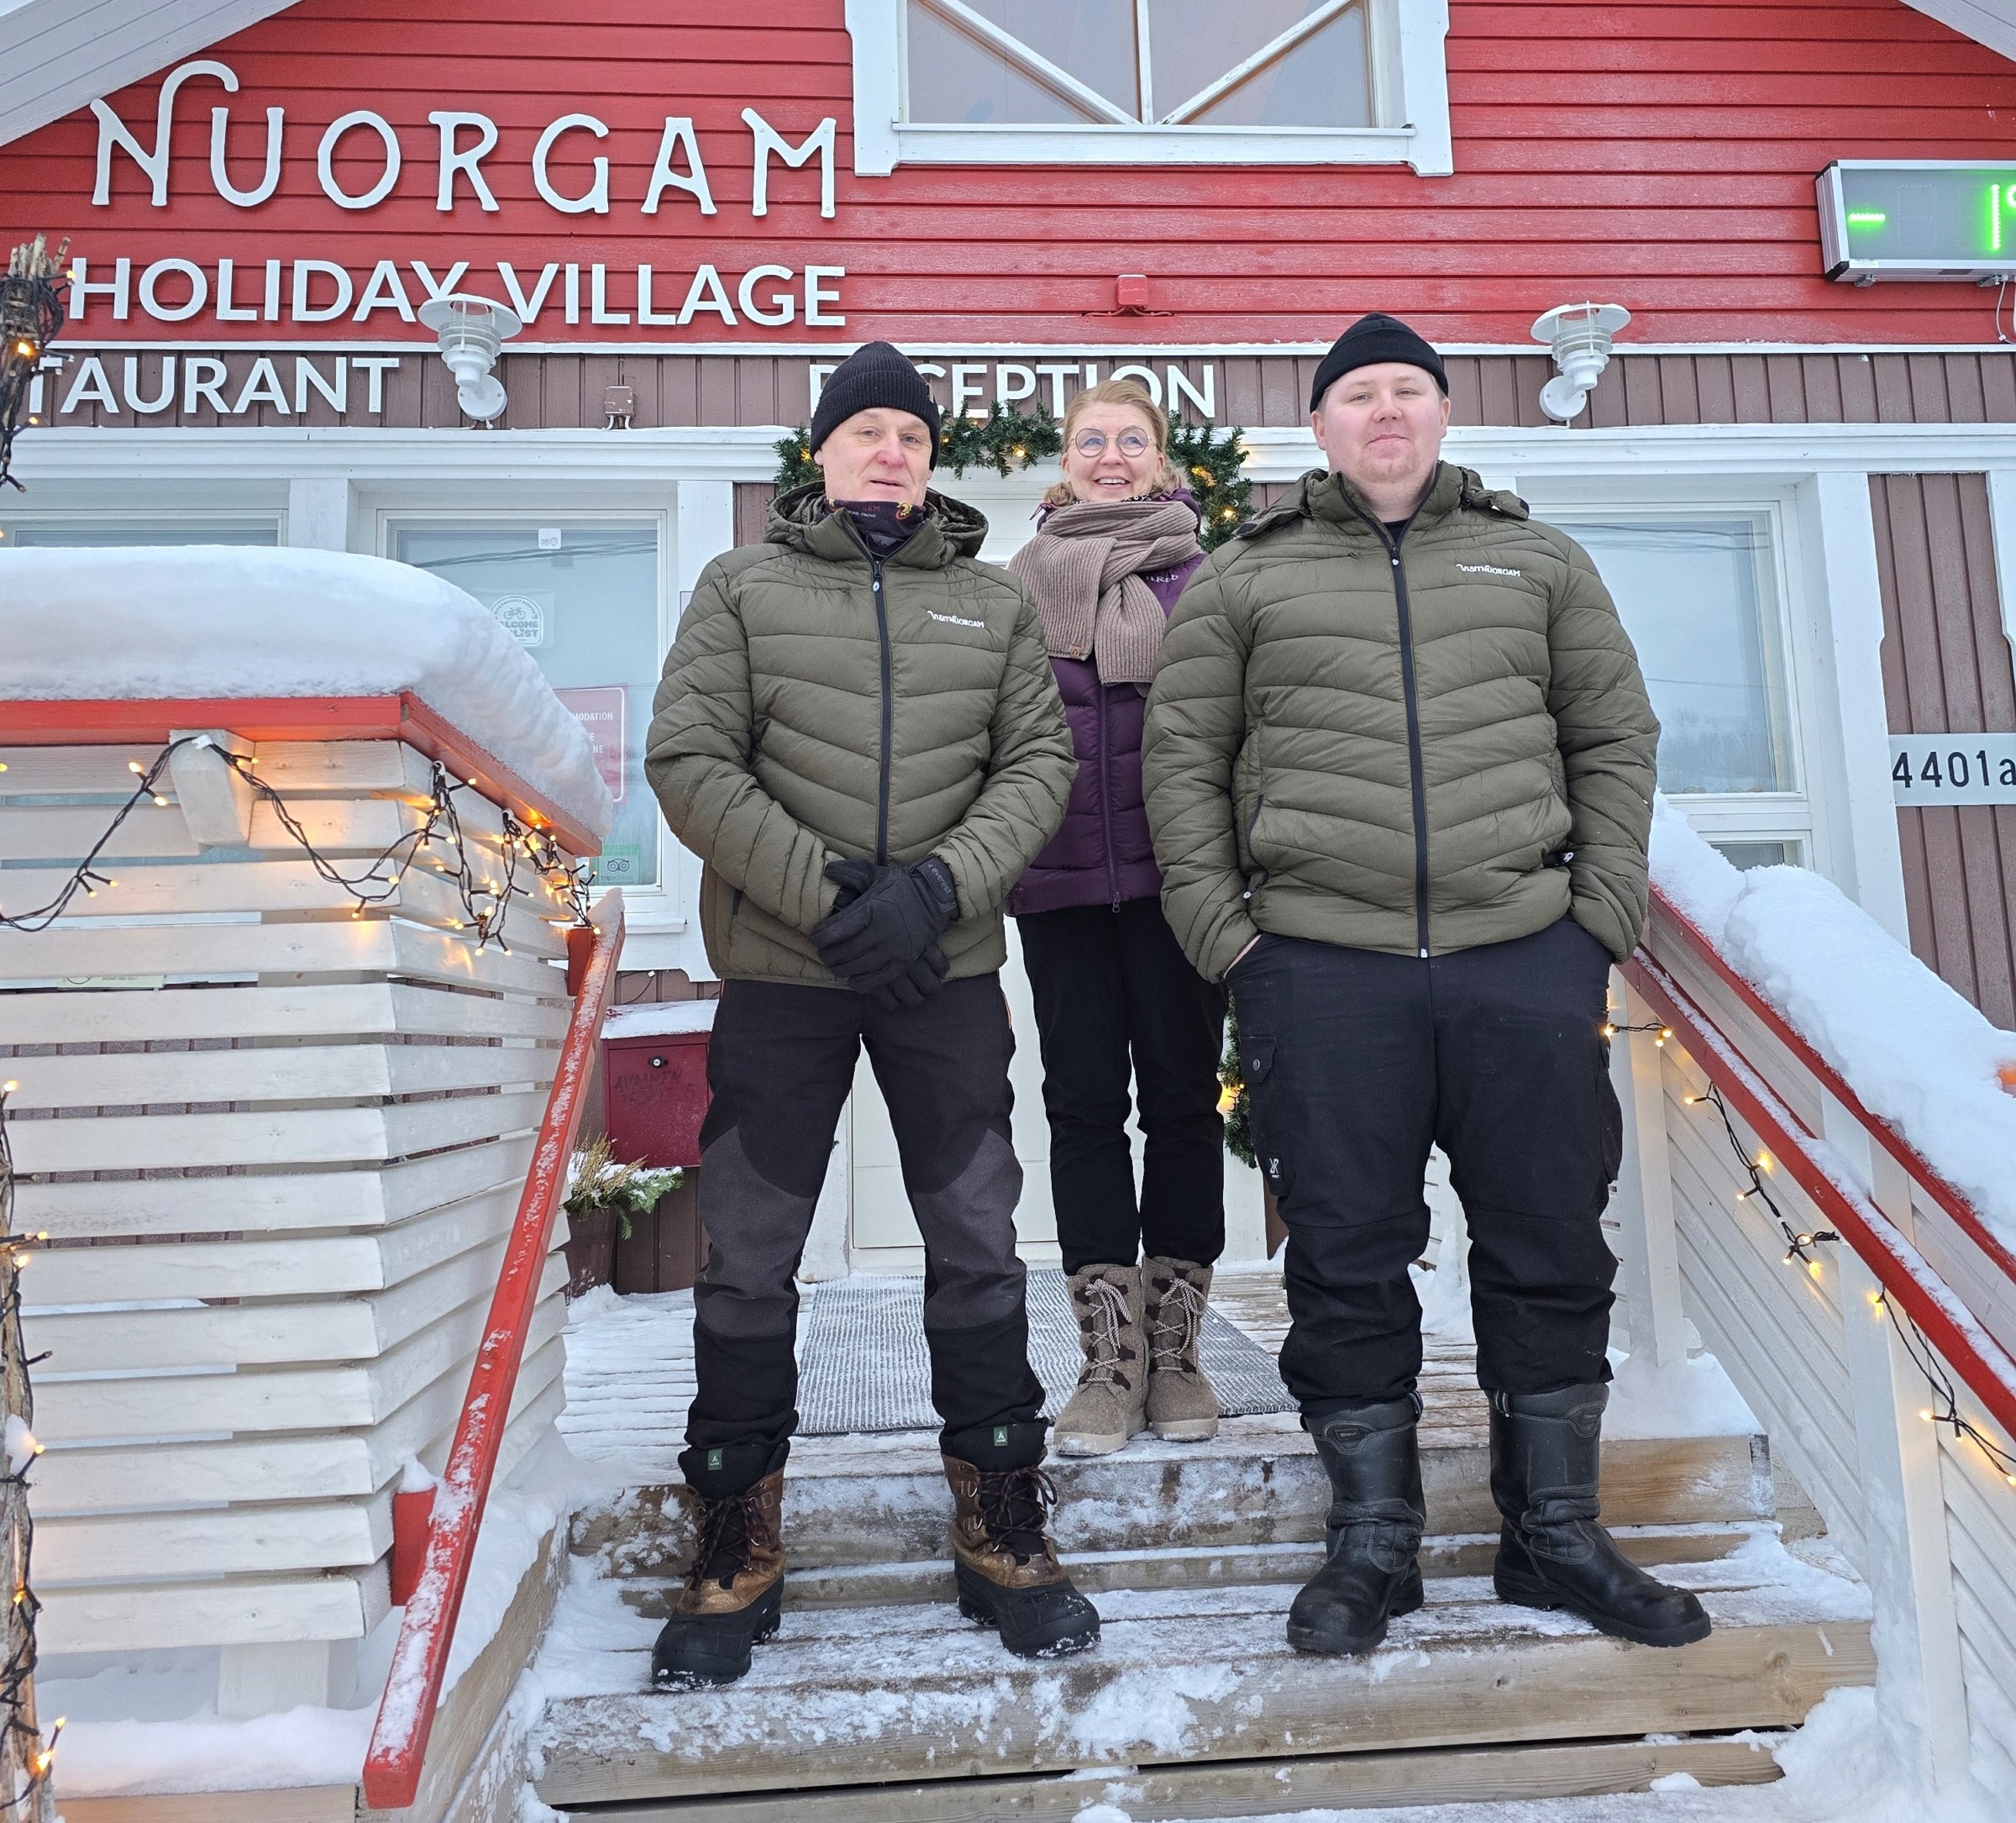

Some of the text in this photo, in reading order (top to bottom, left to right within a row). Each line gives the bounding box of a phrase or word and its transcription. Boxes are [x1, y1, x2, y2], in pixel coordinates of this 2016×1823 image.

[90, 60, 836, 218] NUORGAM
[69, 257, 846, 326] HOLIDAY VILLAGE
[1893, 749, 2016, 788] 4401a
